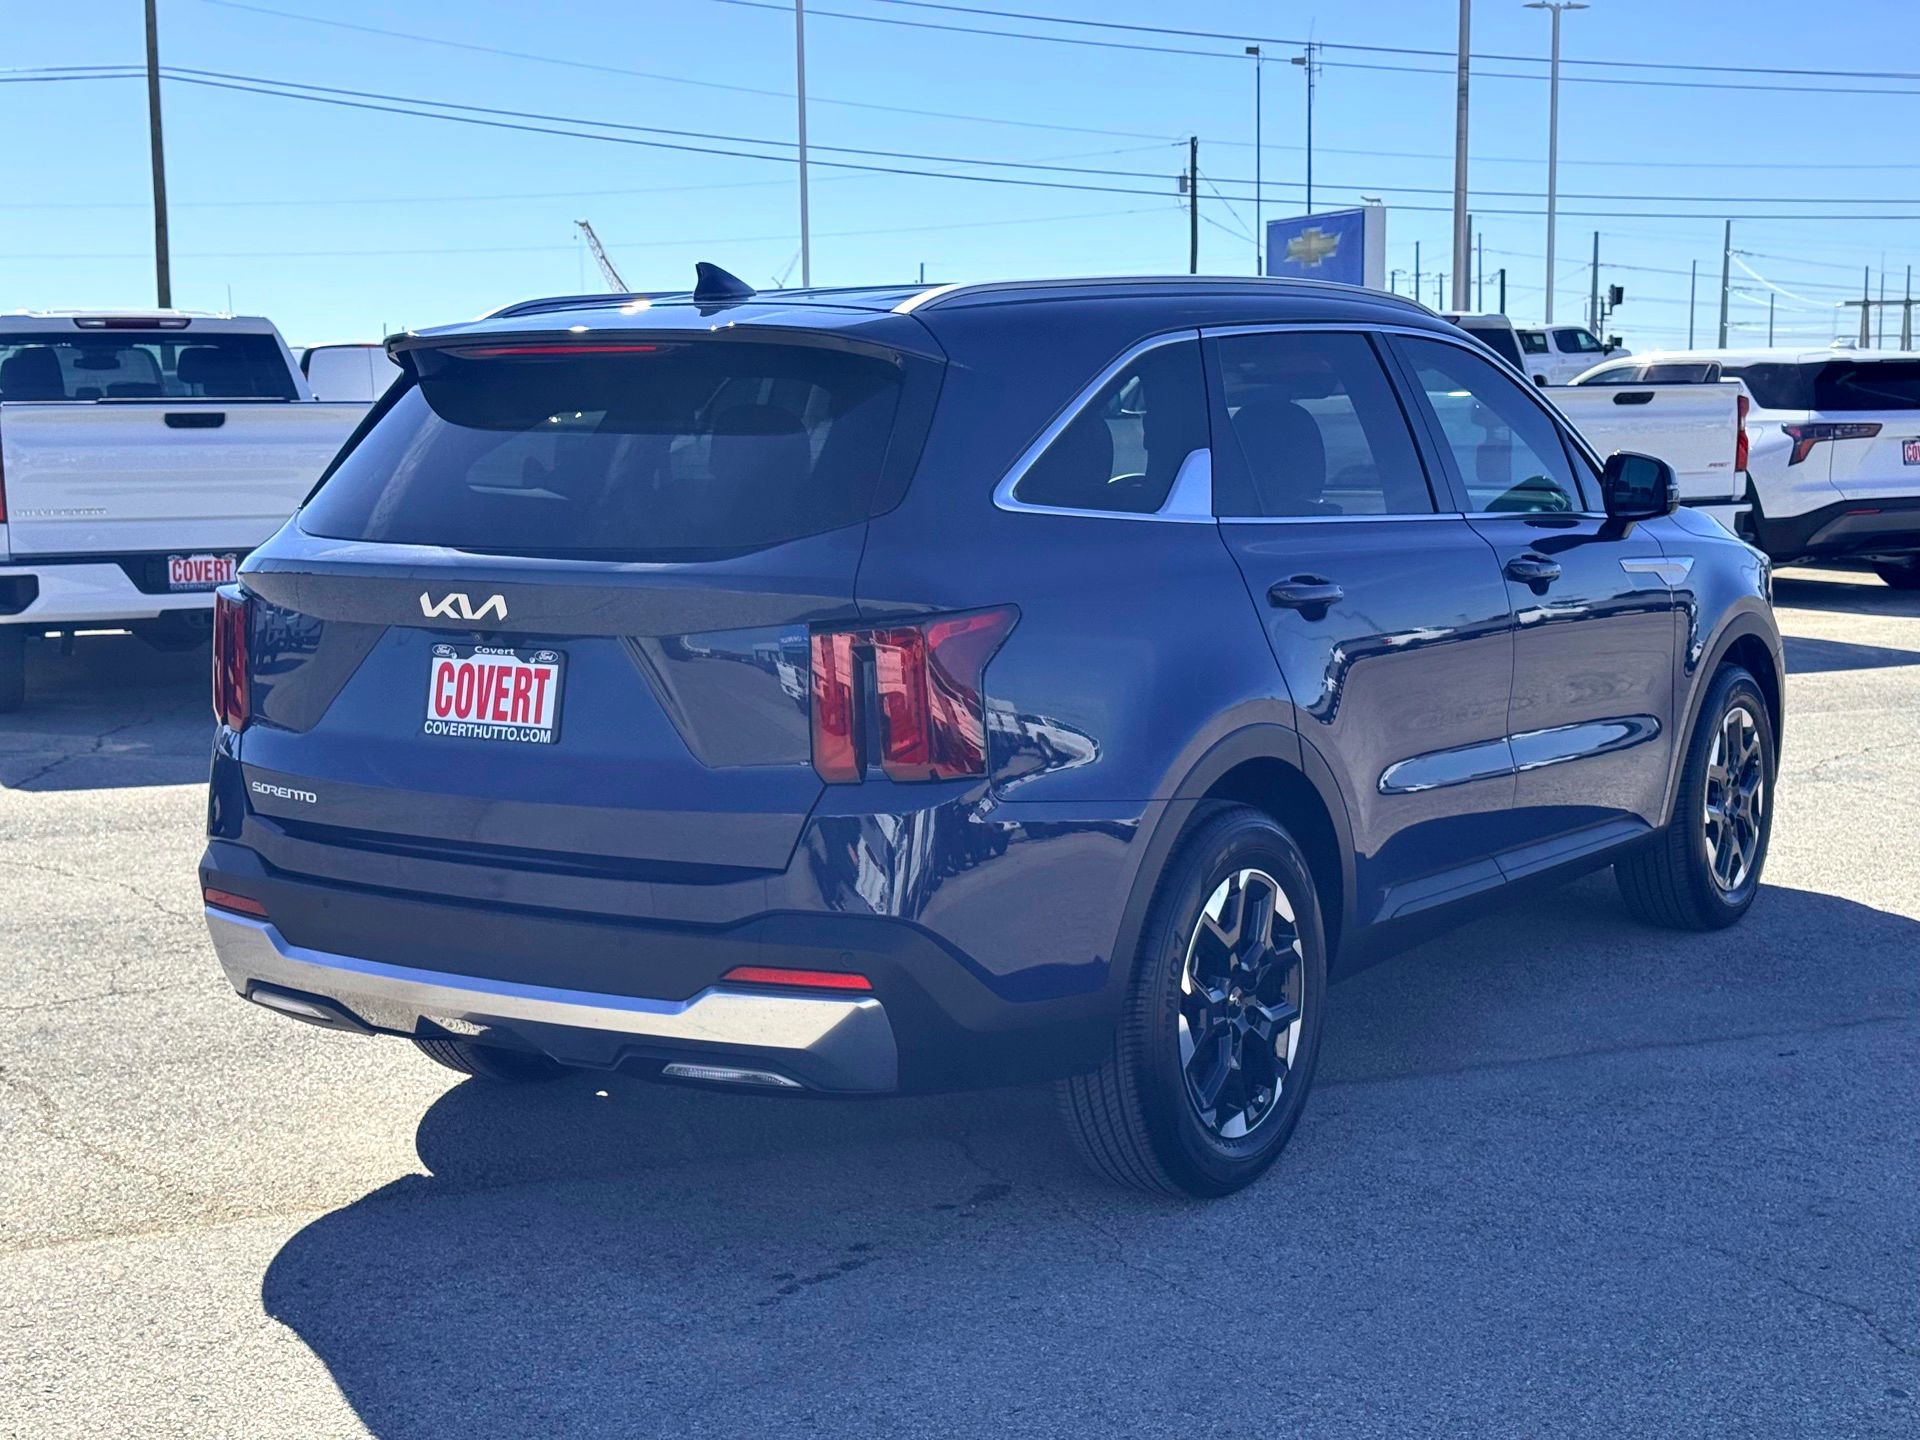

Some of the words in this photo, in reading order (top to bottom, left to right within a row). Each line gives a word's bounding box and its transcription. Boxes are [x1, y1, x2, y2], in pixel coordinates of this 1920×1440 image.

[172, 560, 232, 582] COVERT
[420, 592, 508, 621] KIA
[474, 645, 515, 656] Covert
[435, 661, 552, 725] COVERT
[424, 720, 552, 744] COVERTHUTTO.COM
[252, 781, 317, 804] SORENTO
